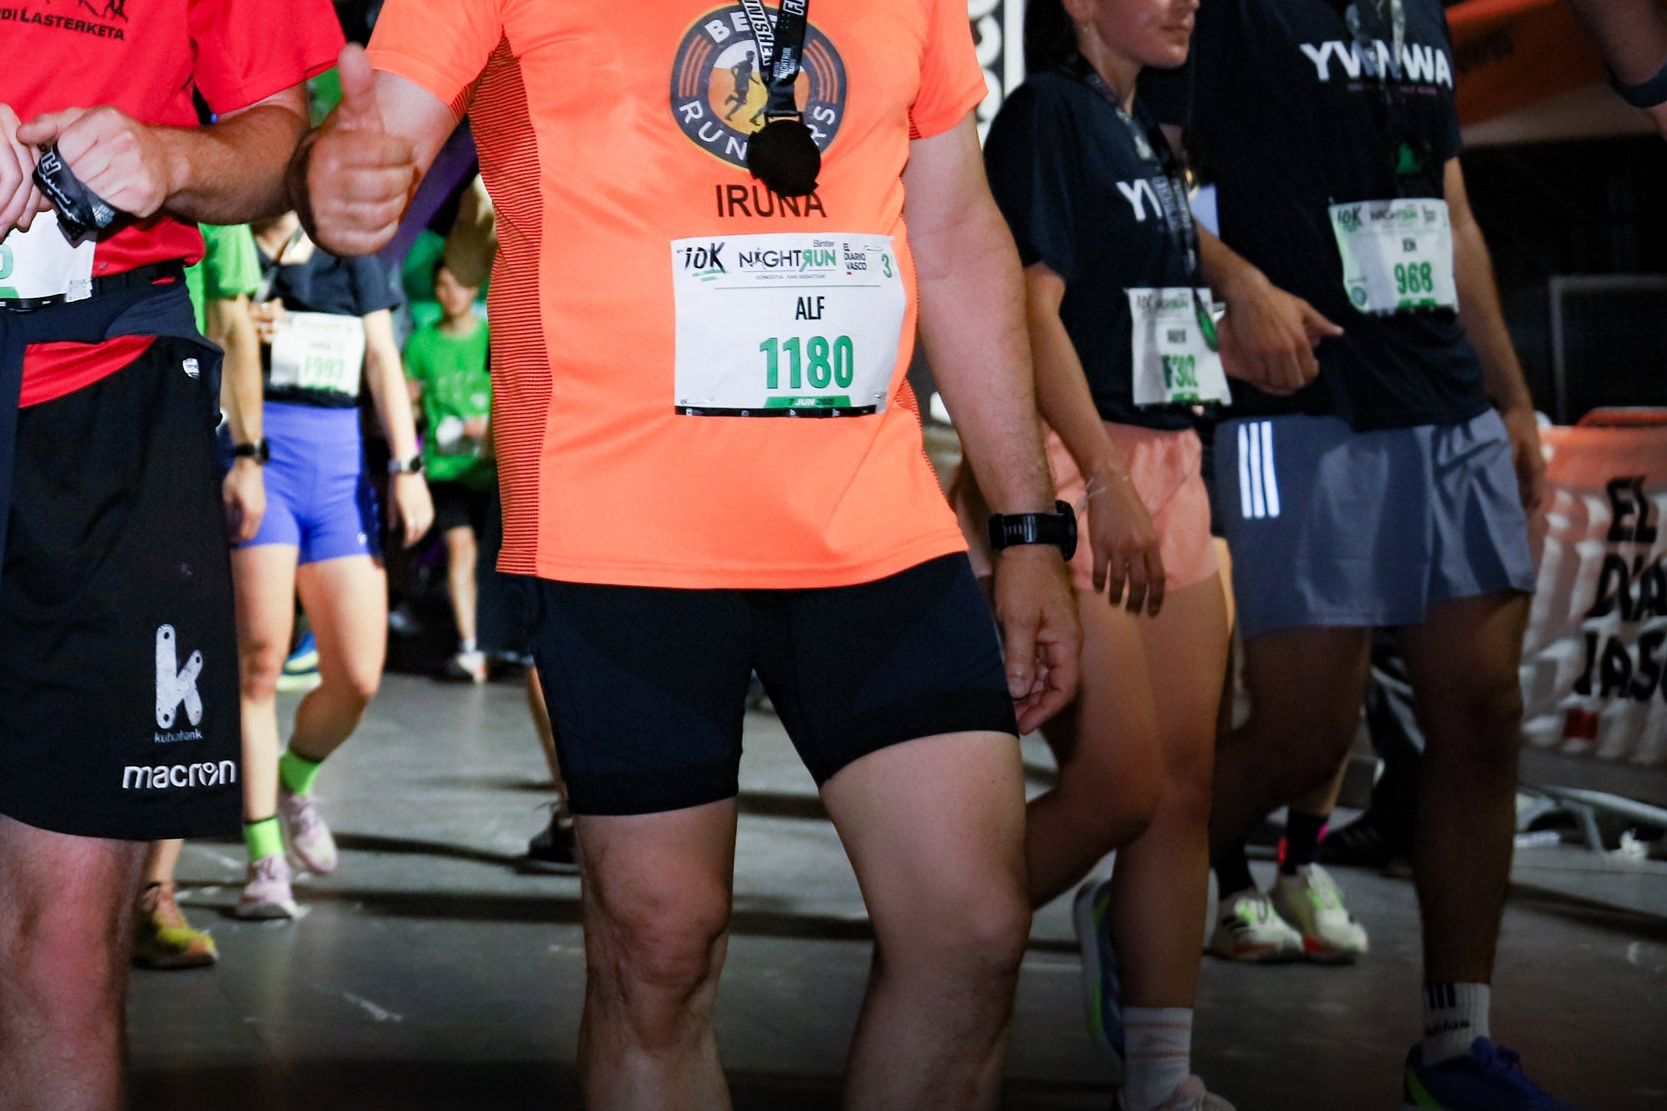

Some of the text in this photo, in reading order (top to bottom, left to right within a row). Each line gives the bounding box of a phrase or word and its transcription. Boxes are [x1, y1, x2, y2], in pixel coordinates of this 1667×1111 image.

[21, 8, 125, 41] LASTERKETA
[845, 262, 867, 271] VASCO
[881, 253, 893, 279] 3
[795, 296, 825, 320] ALF
[759, 335, 854, 390] 1180
[1606, 475, 1658, 543] EL
[122, 760, 236, 790] macron
